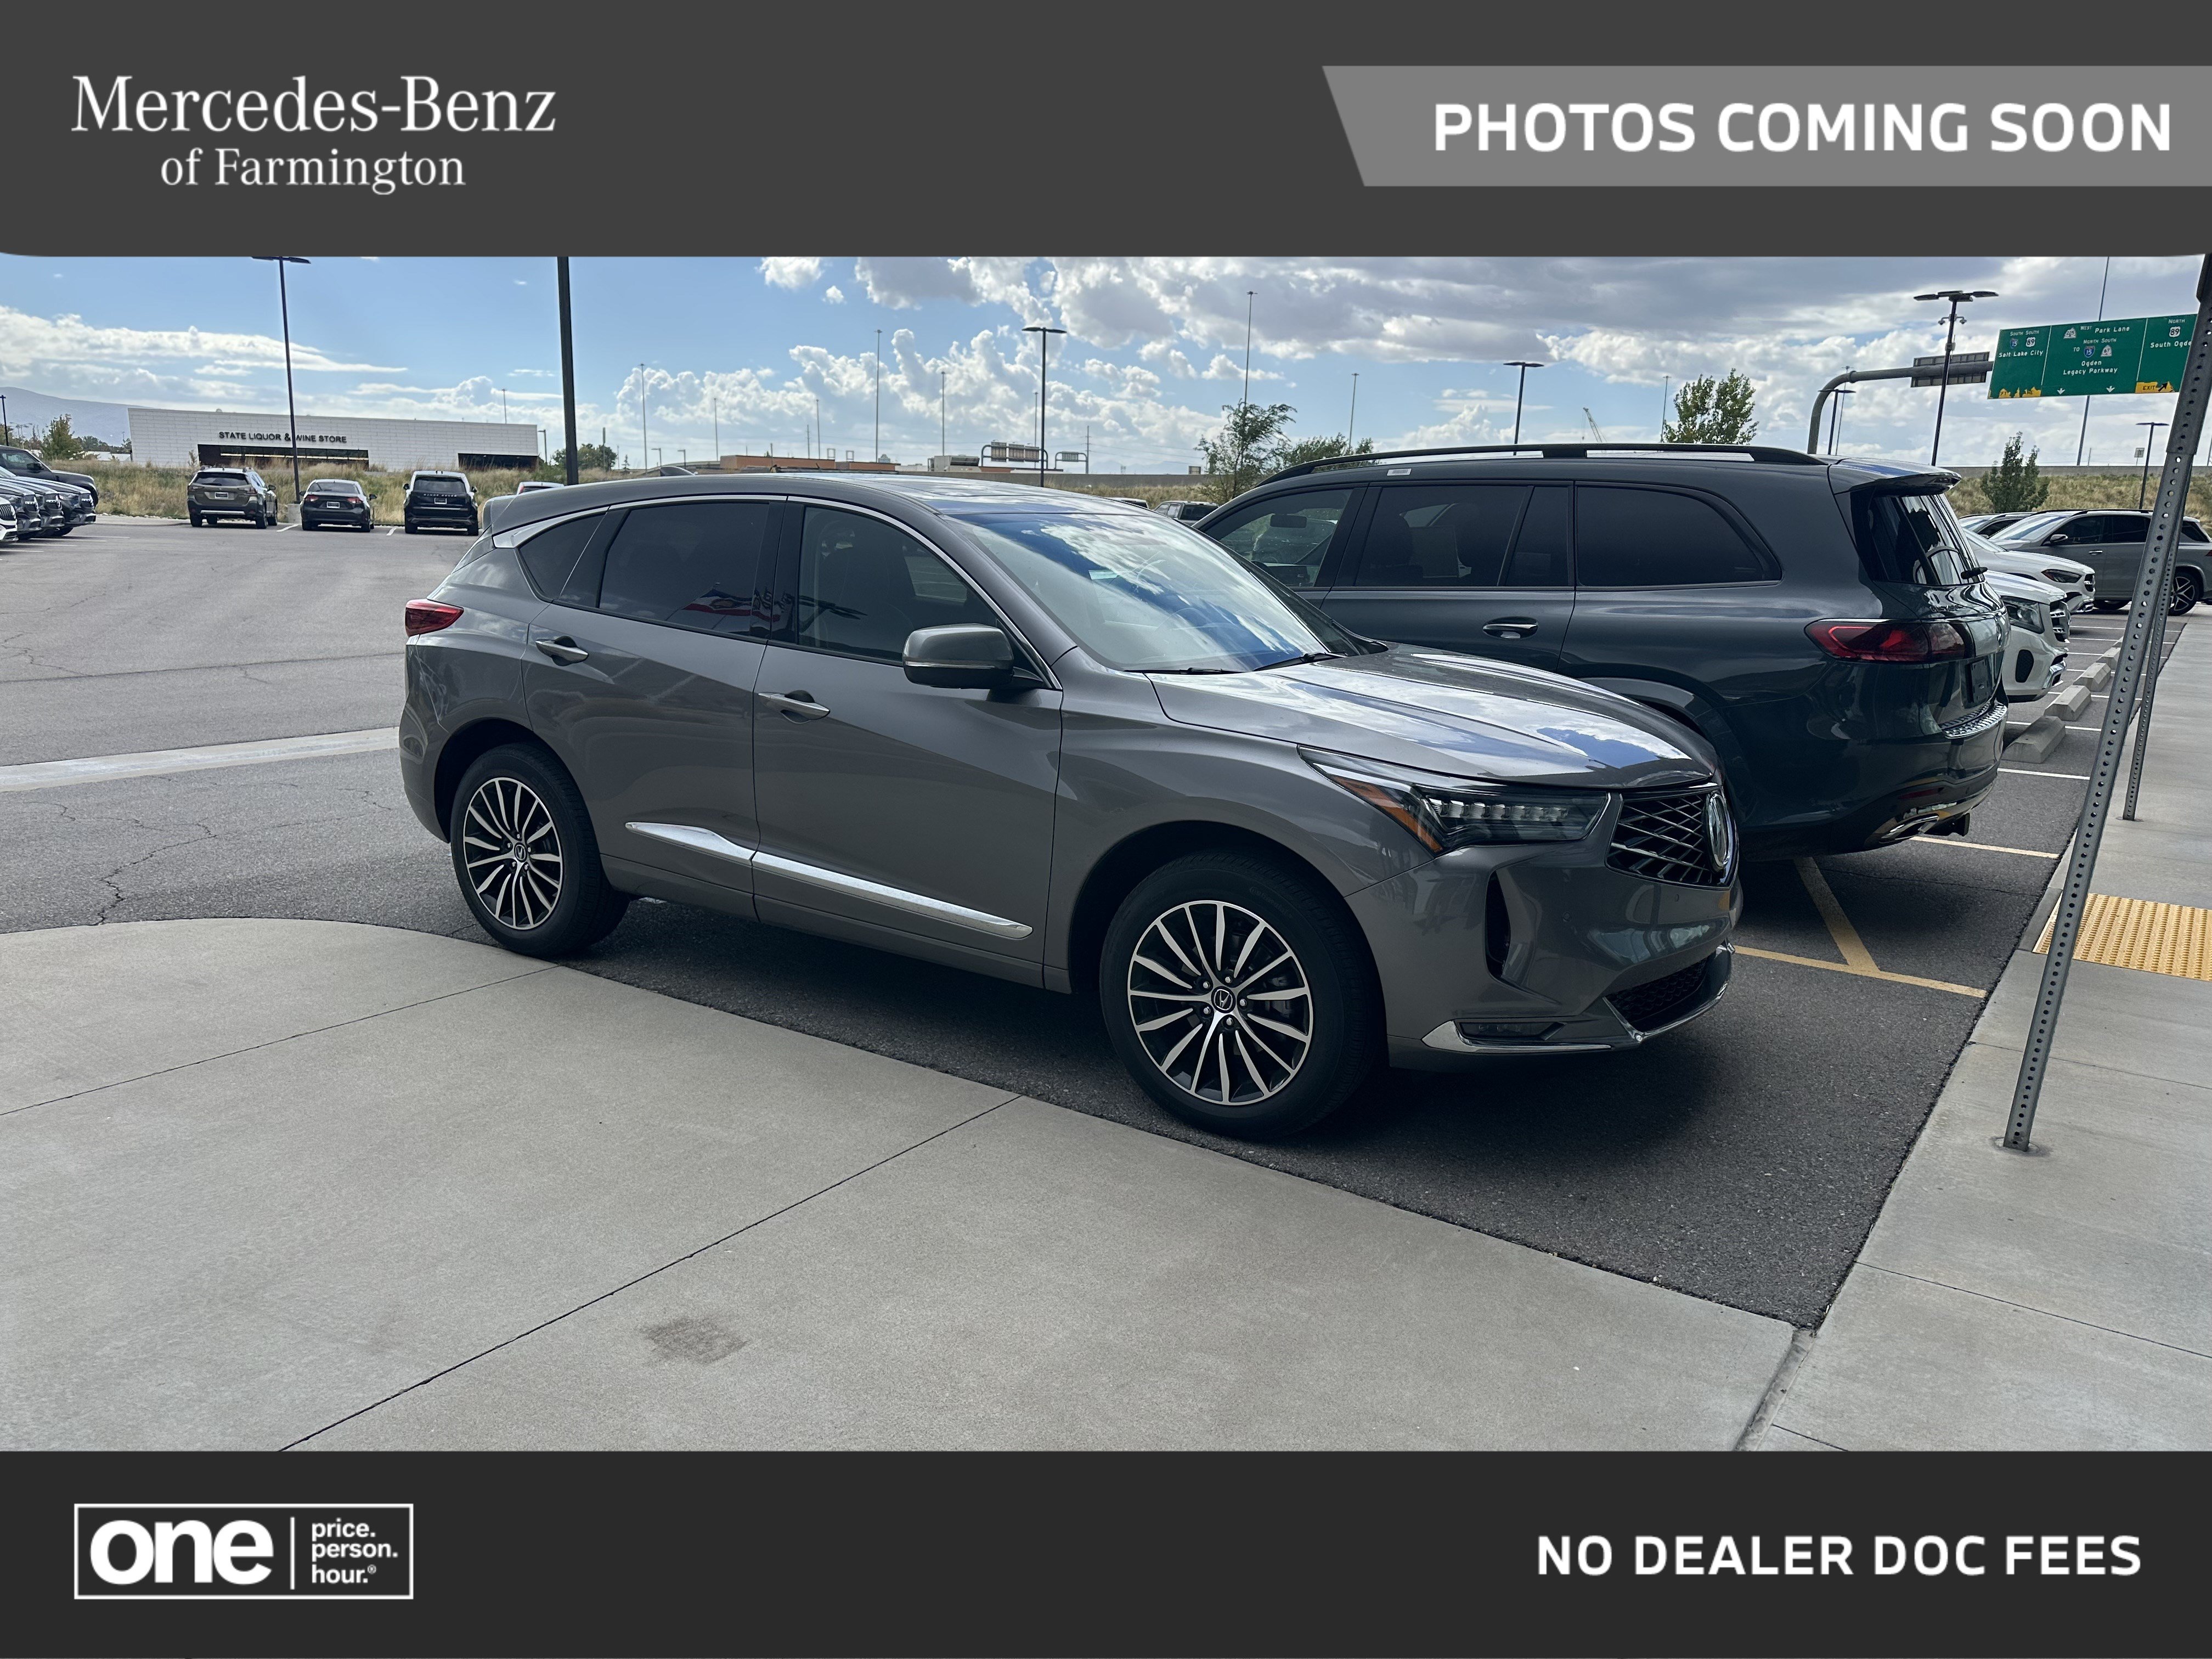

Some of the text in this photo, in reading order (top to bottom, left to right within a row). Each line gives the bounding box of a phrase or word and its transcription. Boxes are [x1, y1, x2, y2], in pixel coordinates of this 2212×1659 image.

[219, 431, 246, 439] STATE
[249, 432, 281, 441] LIQUOR
[284, 433, 291, 442] &
[319, 435, 347, 443] STORE
